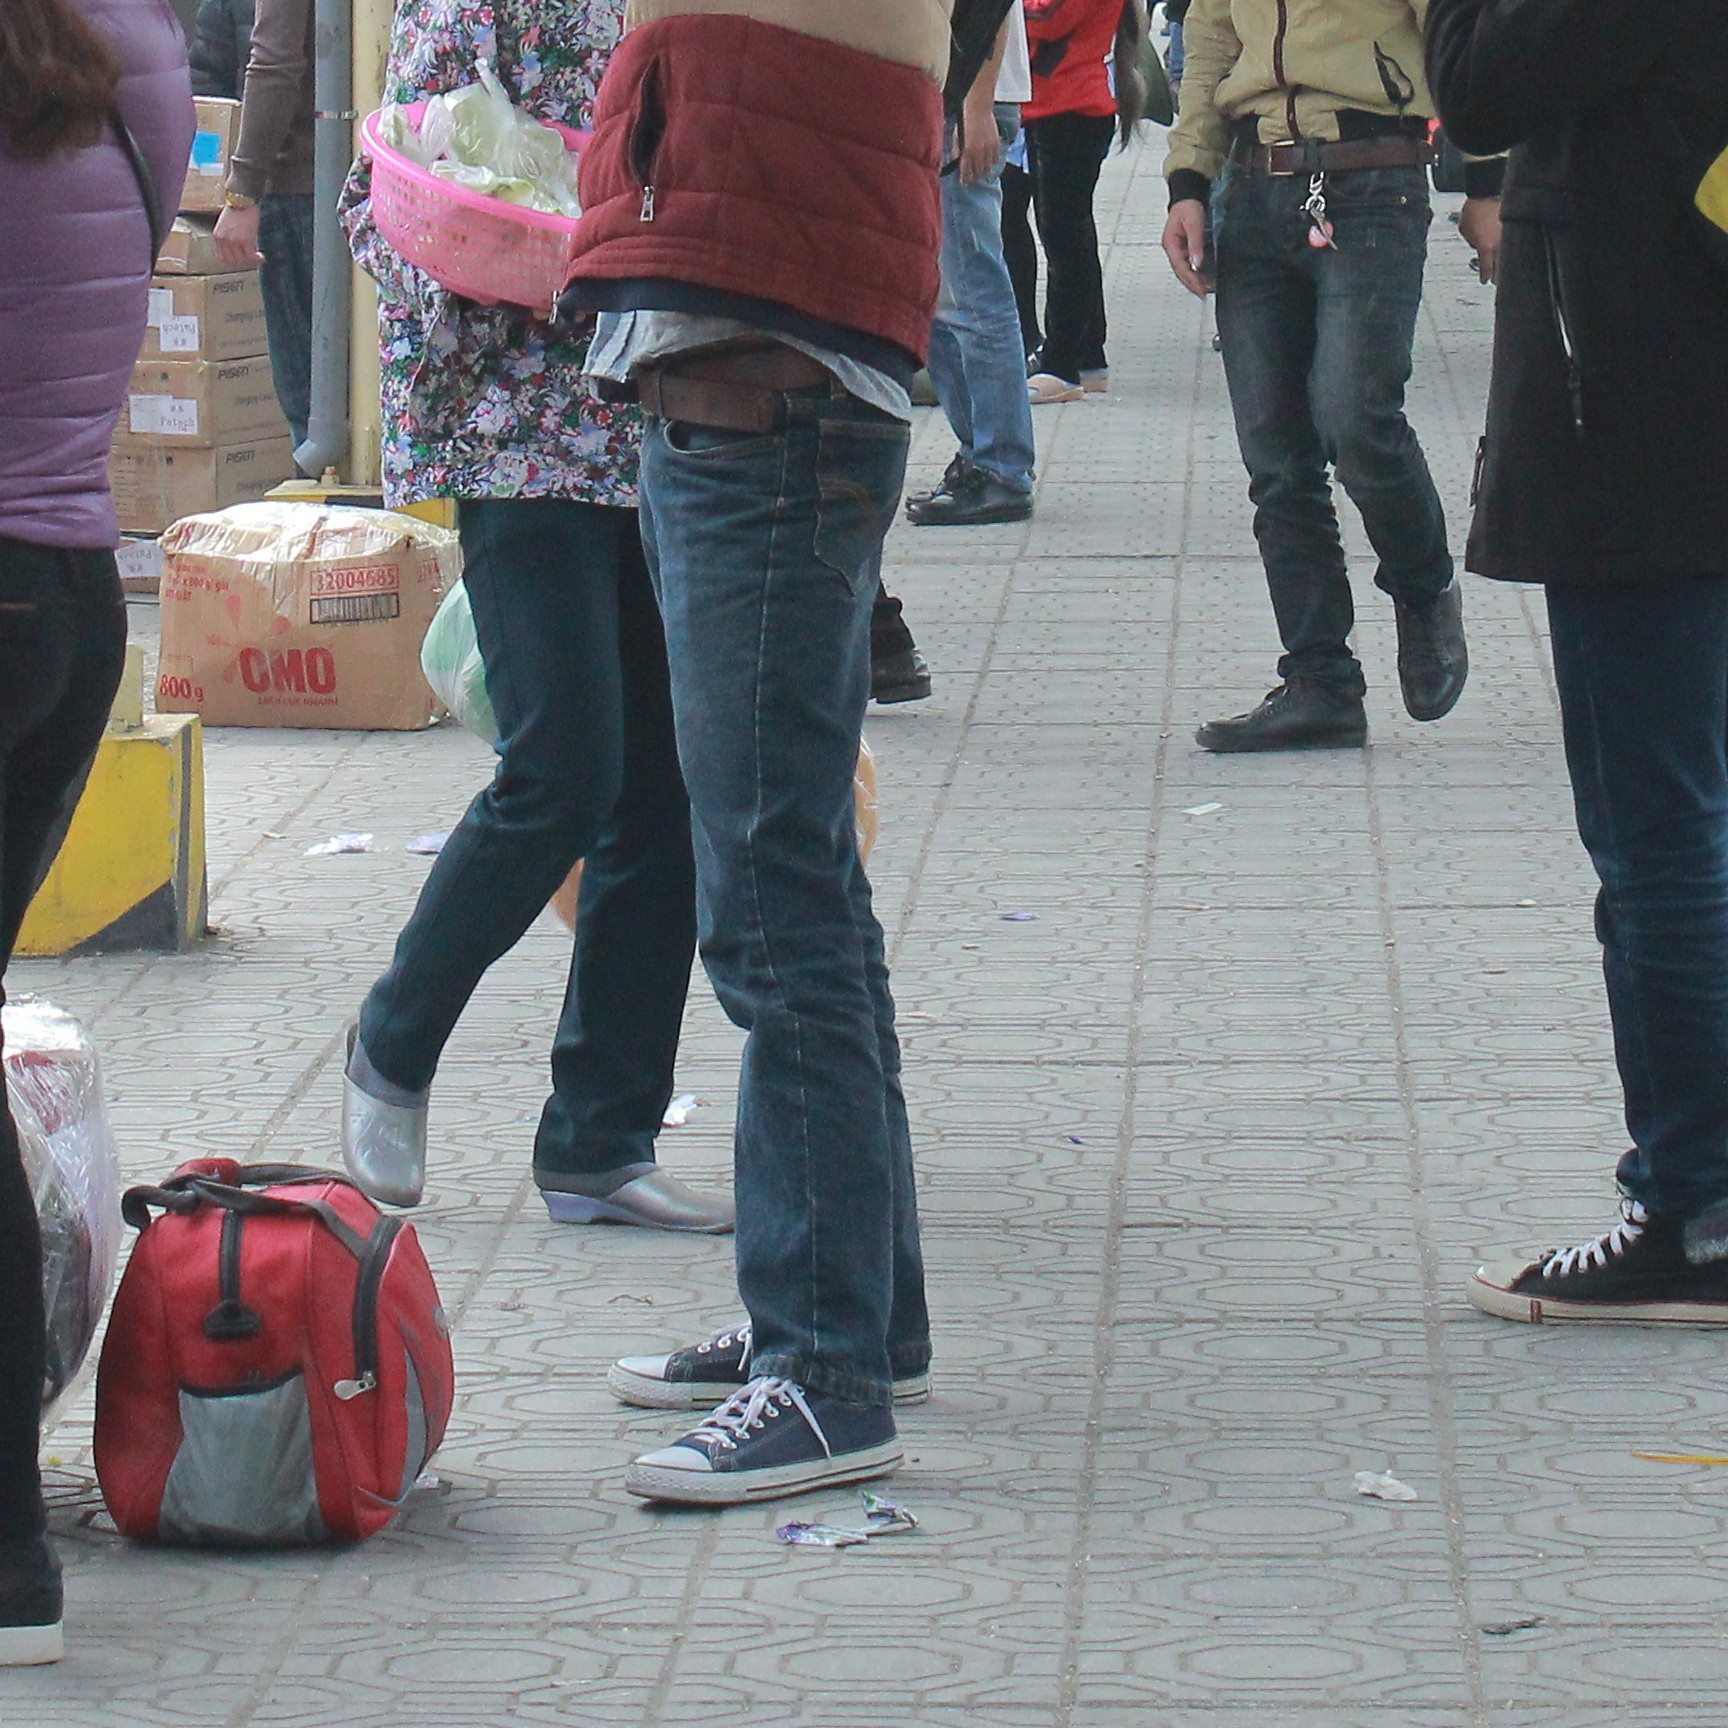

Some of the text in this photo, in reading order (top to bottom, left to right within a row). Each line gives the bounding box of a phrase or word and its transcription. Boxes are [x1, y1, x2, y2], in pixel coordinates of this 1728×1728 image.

[317, 568, 396, 592] 32004685
[239, 645, 337, 696] OMO
[159, 673, 204, 702] 800 g
